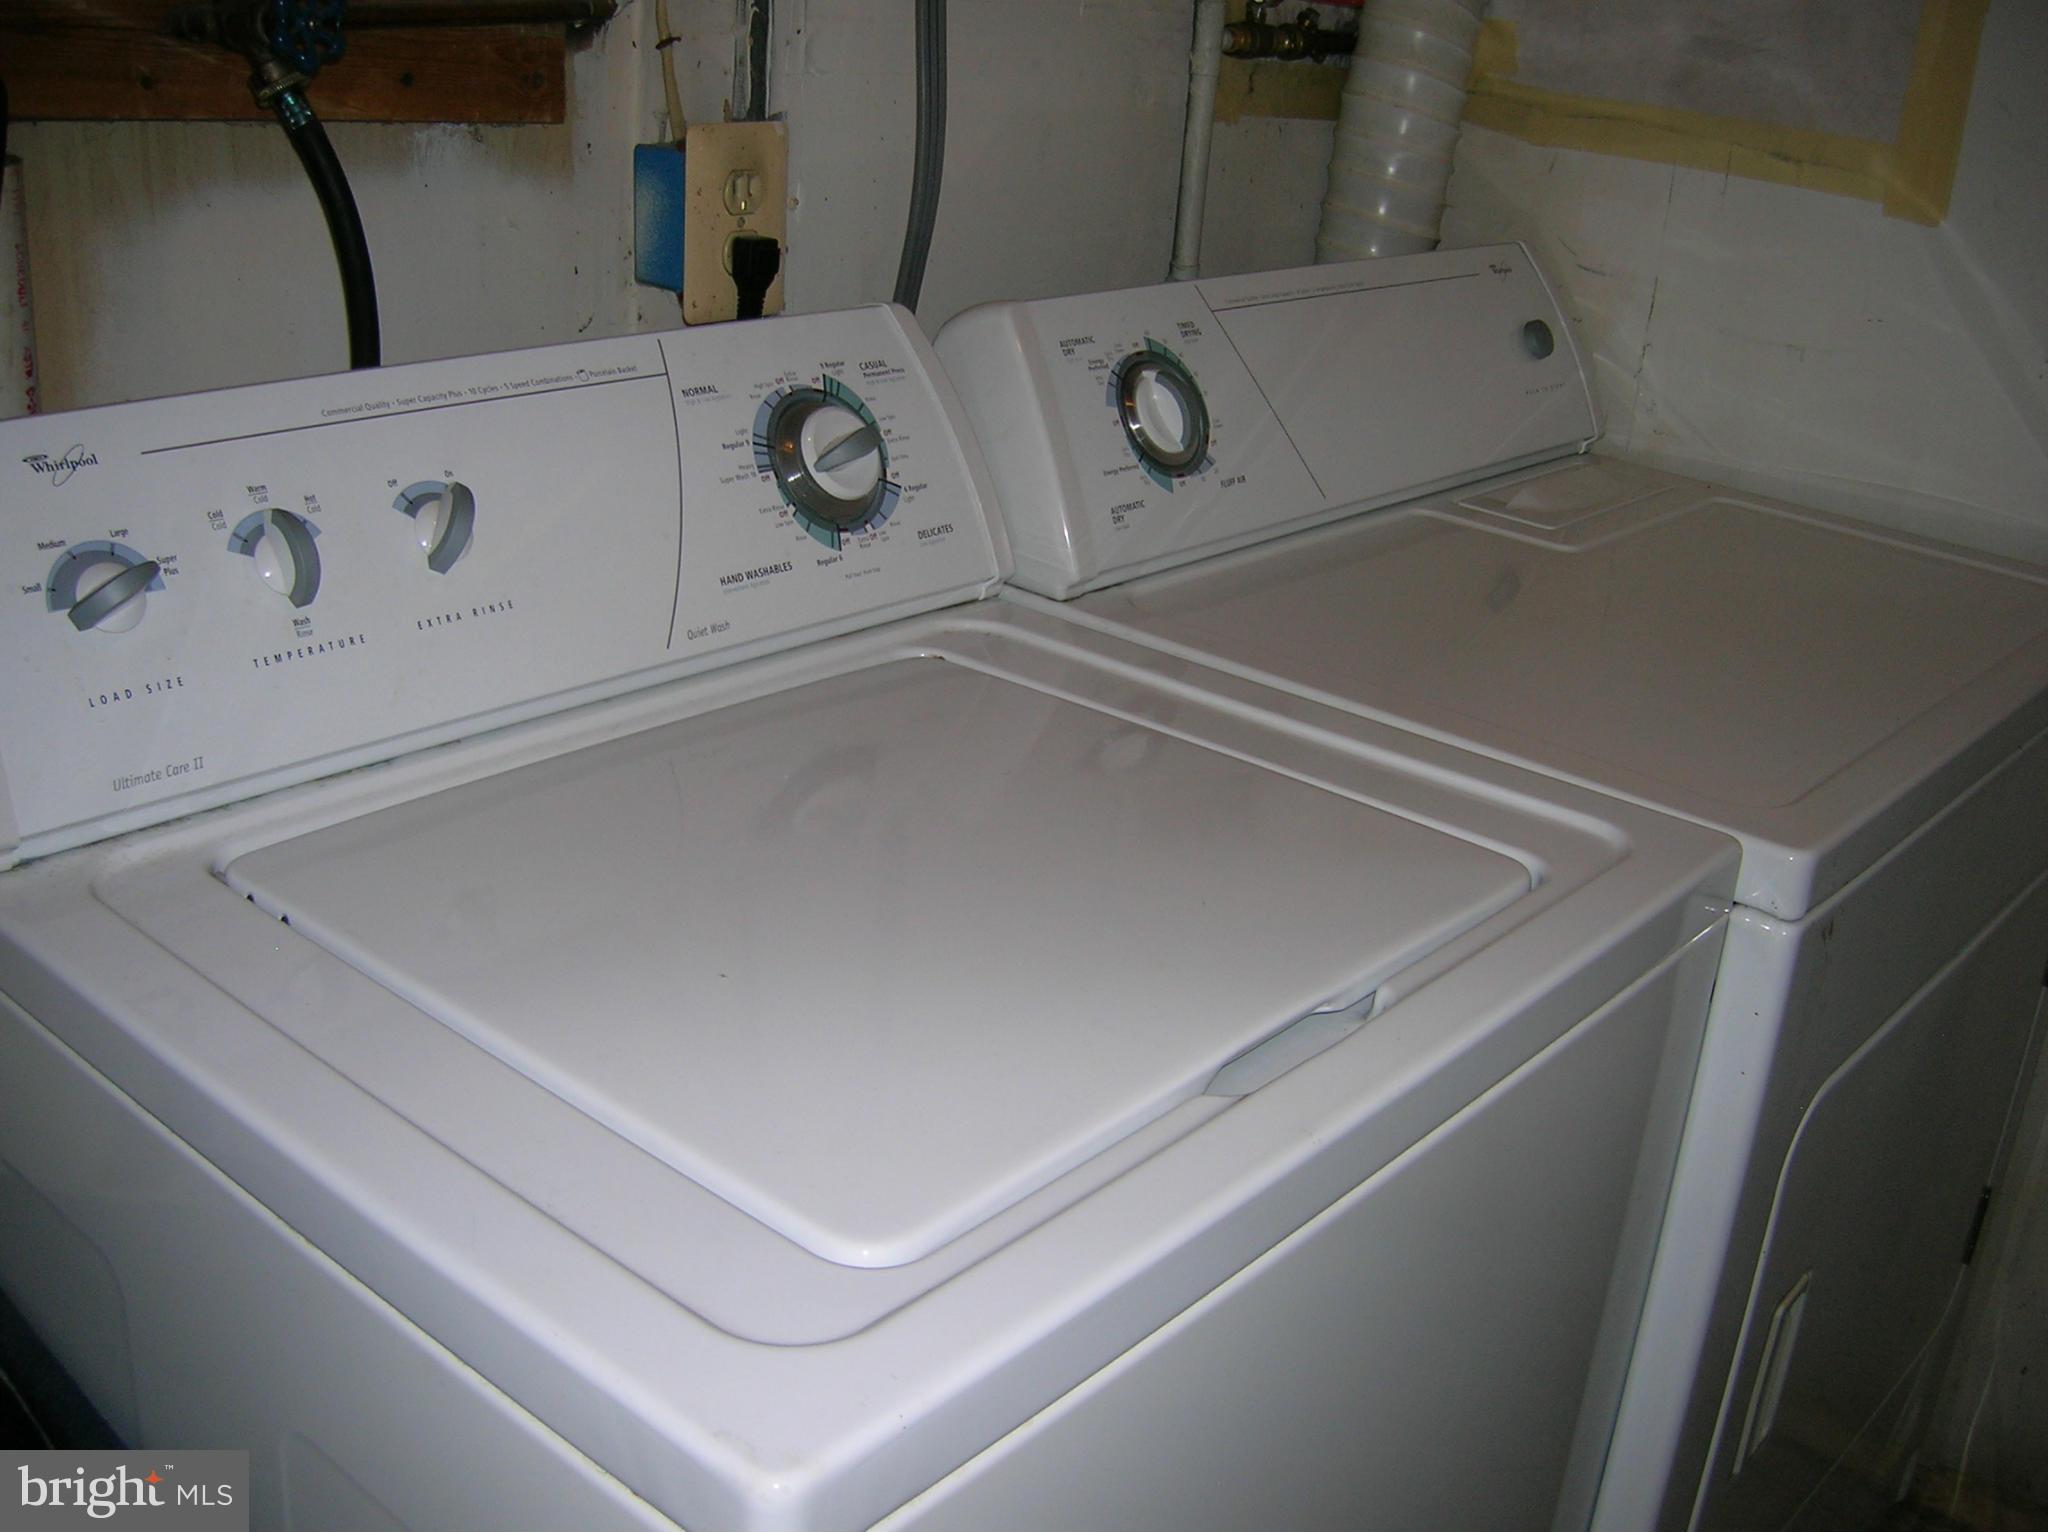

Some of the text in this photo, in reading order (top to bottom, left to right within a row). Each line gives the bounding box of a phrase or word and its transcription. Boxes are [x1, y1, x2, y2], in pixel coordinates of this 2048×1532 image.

[1180, 328, 1203, 339] DRYING
[1059, 335, 1096, 348] AUTOMATIC
[1062, 348, 1076, 358] DRY
[859, 360, 887, 371] CASUAL
[863, 369, 891, 378] Permanent
[321, 399, 364, 417] Commercial
[365, 399, 391, 412] Quality
[396, 395, 416, 408] Super
[417, 390, 447, 406] Capacity
[448, 389, 463, 399] Plus
[477, 383, 499, 395] Cycles
[510, 378, 530, 390] Speed
[530, 374, 574, 387] Combinations
[589, 368, 617, 378] Porcelain
[682, 384, 719, 398] NORMAL
[721, 440, 745, 451] Regular
[30, 453, 98, 475] Whirlpool
[444, 468, 454, 478] On
[387, 478, 399, 488] Off
[908, 482, 928, 493] Regular
[1219, 474, 1248, 490] FLUFF AIR
[307, 504, 322, 514] Cold
[1110, 499, 1146, 516] AUTOMATIC
[208, 509, 224, 520] Cold
[1111, 514, 1126, 525] DRY
[211, 520, 227, 531] Cold
[917, 523, 954, 541] DELICATES
[109, 527, 129, 540] Large
[37, 538, 67, 551] Medium
[156, 553, 178, 567] Super
[817, 556, 838, 568] Regular
[163, 565, 180, 577] Plus
[720, 571, 744, 587] HAND
[745, 561, 793, 582] WASHABLES
[22, 582, 42, 595] Small
[417, 599, 515, 631] EXTRA RINSE
[292, 616, 311, 628] Wash
[687, 620, 731, 640] Quiet Wash
[253, 633, 366, 669] TEMPERATURE
[88, 675, 184, 709] LOAD SIZE
[112, 756, 205, 793] Ultimate Care II
